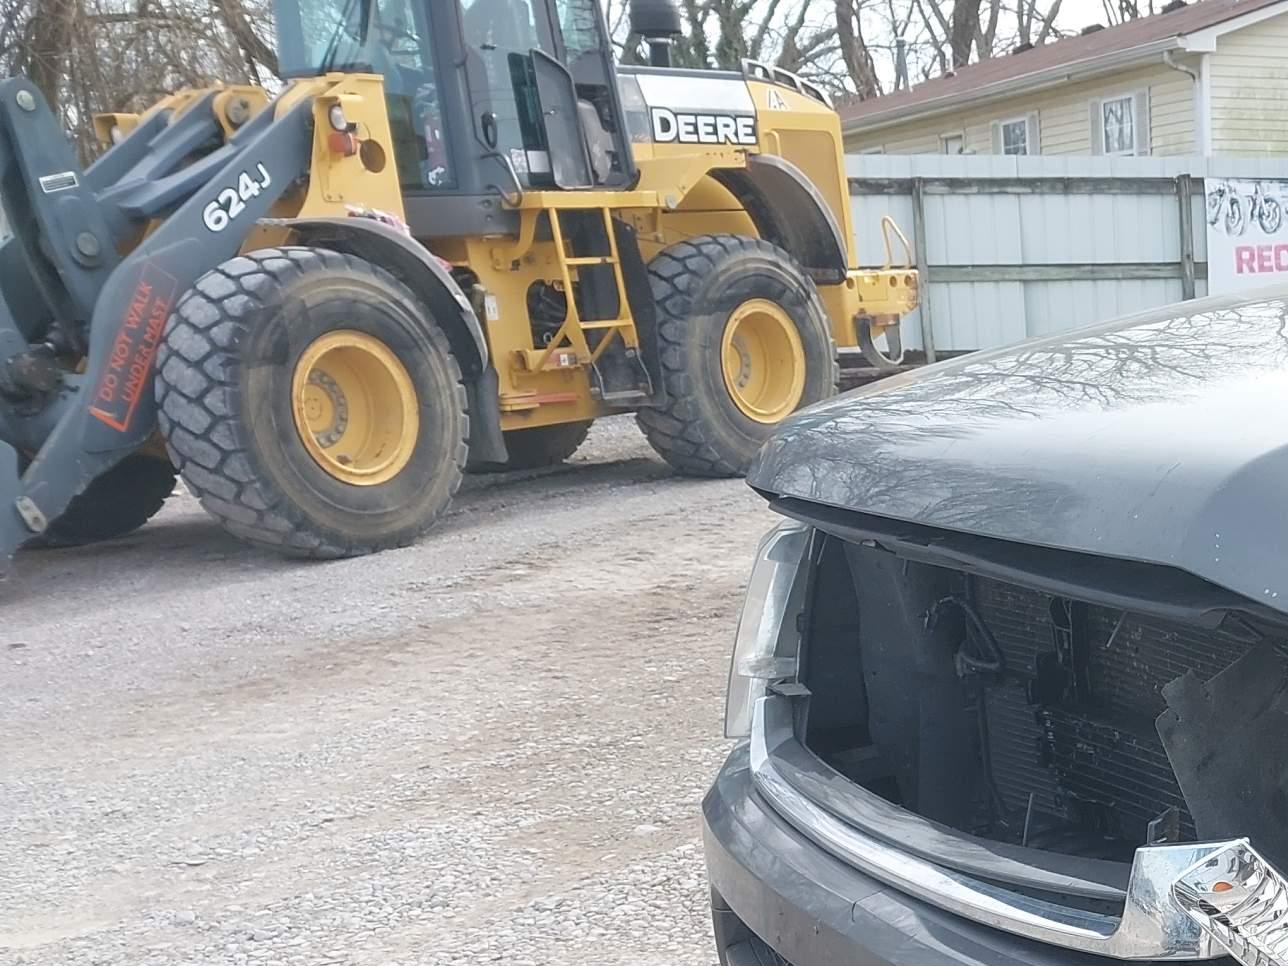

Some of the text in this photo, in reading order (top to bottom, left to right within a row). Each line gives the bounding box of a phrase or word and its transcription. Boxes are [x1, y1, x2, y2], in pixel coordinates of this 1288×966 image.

[650, 106, 757, 145] DEERE
[203, 162, 272, 233] 624J
[101, 281, 153, 402] DO NOT WALK
[121, 296, 168, 403] UNDER MAST
